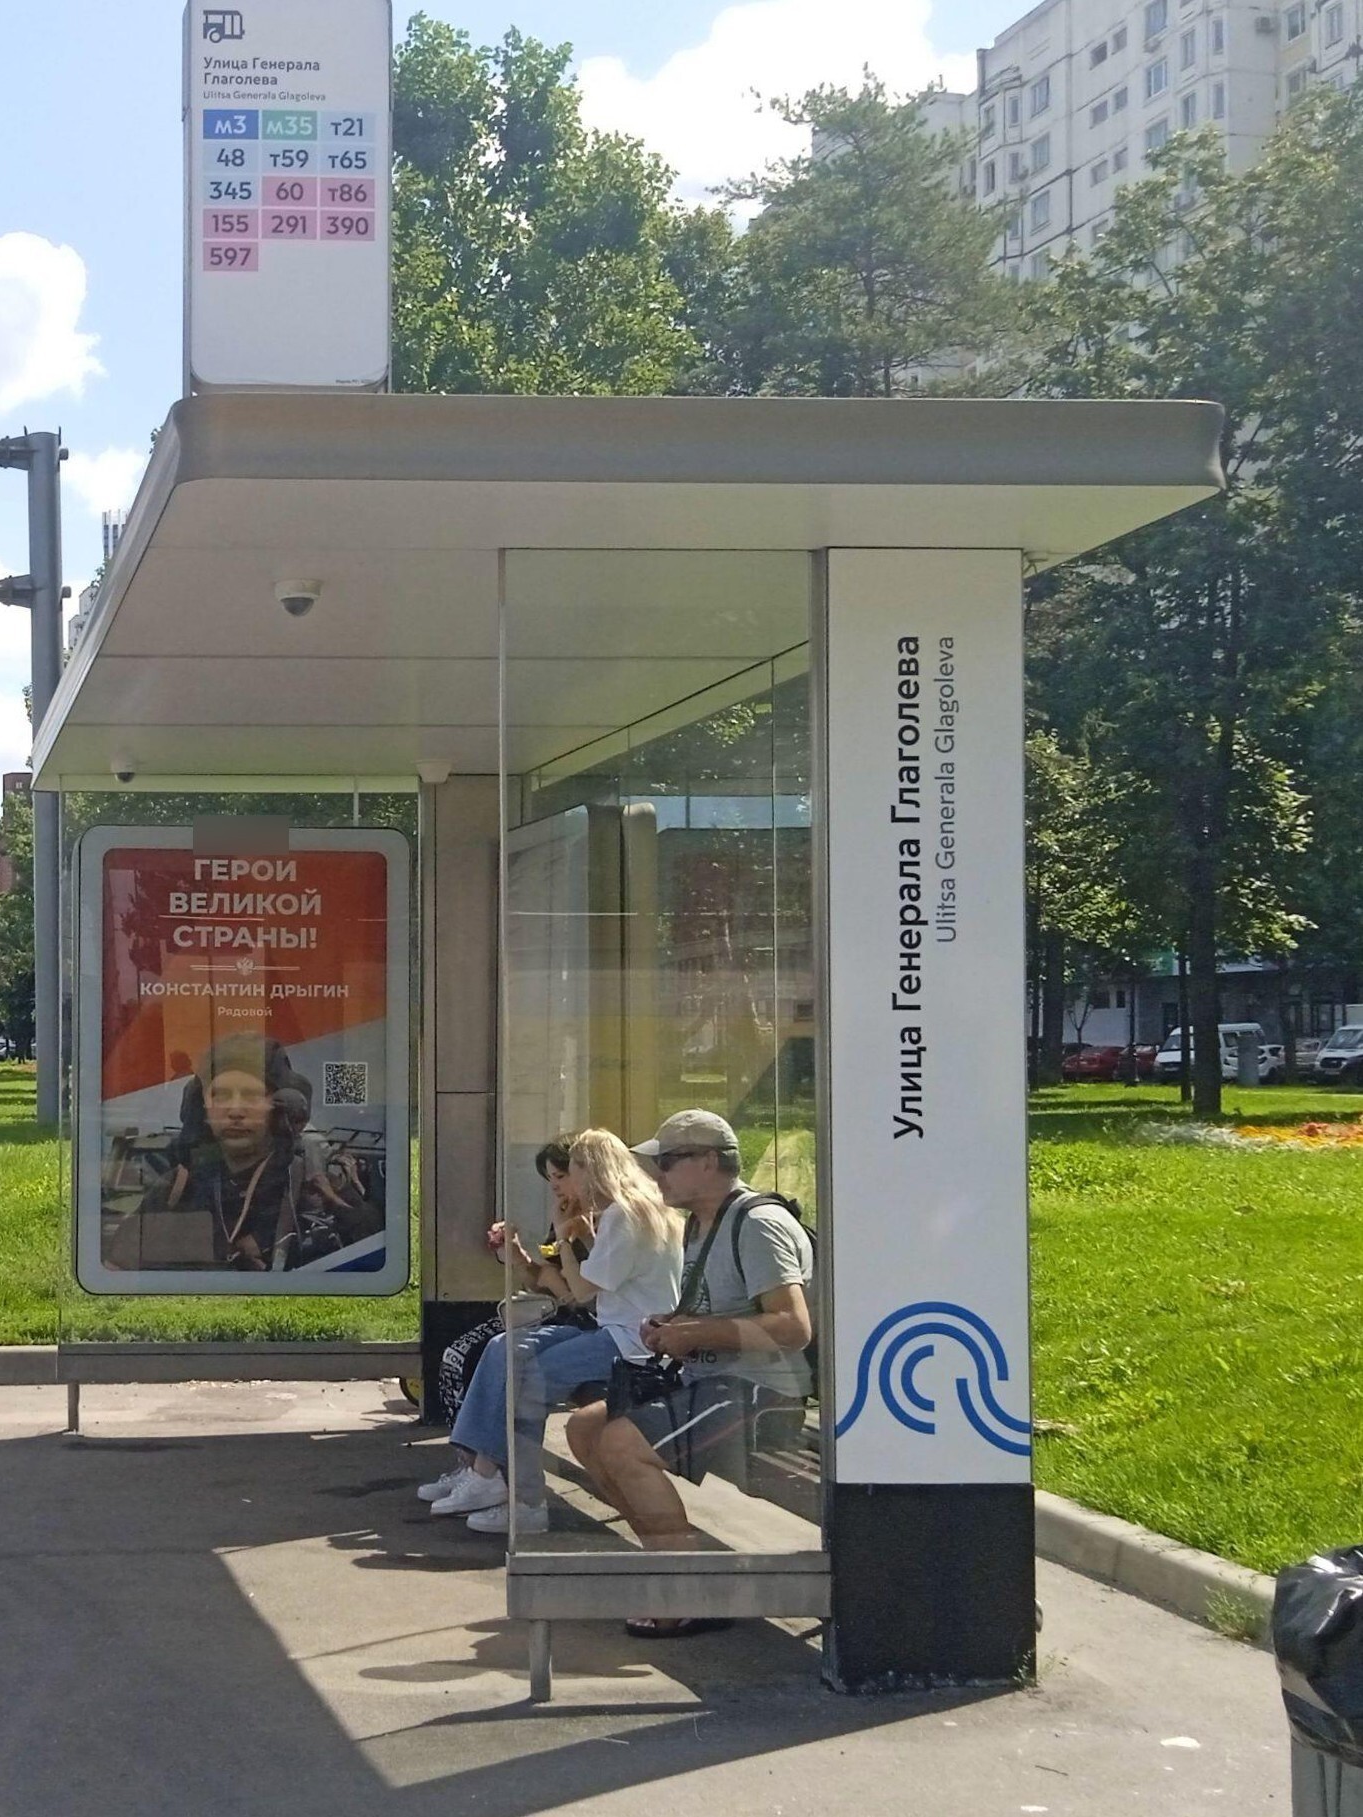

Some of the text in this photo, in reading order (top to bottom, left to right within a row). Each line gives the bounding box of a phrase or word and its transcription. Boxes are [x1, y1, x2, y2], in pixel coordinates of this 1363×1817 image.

[203, 56, 320, 72] Улица Генерала
[203, 73, 278, 86] Глаголева
[203, 91, 326, 102] Ulitsa Generala Glagoleva
[214, 115, 364, 137] м3 м35 т21
[216, 148, 367, 170] 48 т59 т65
[209, 181, 367, 202] 345 60 т86
[212, 215, 369, 235] 155 291 390
[209, 248, 252, 266] 597
[933, 636, 959, 943] Ulitsa Generala Glagoleva
[194, 859, 297, 882] ГЕРОИ
[890, 636, 929, 1140] Улица Генерала Глаголева
[169, 889, 322, 916] ВЕЛИКОЙ
[172, 925, 318, 949] СТРАНЫ!
[140, 982, 349, 1000] КОНСТАНТИН ДРЫГИН
[217, 1005, 272, 1018] Рядовой
